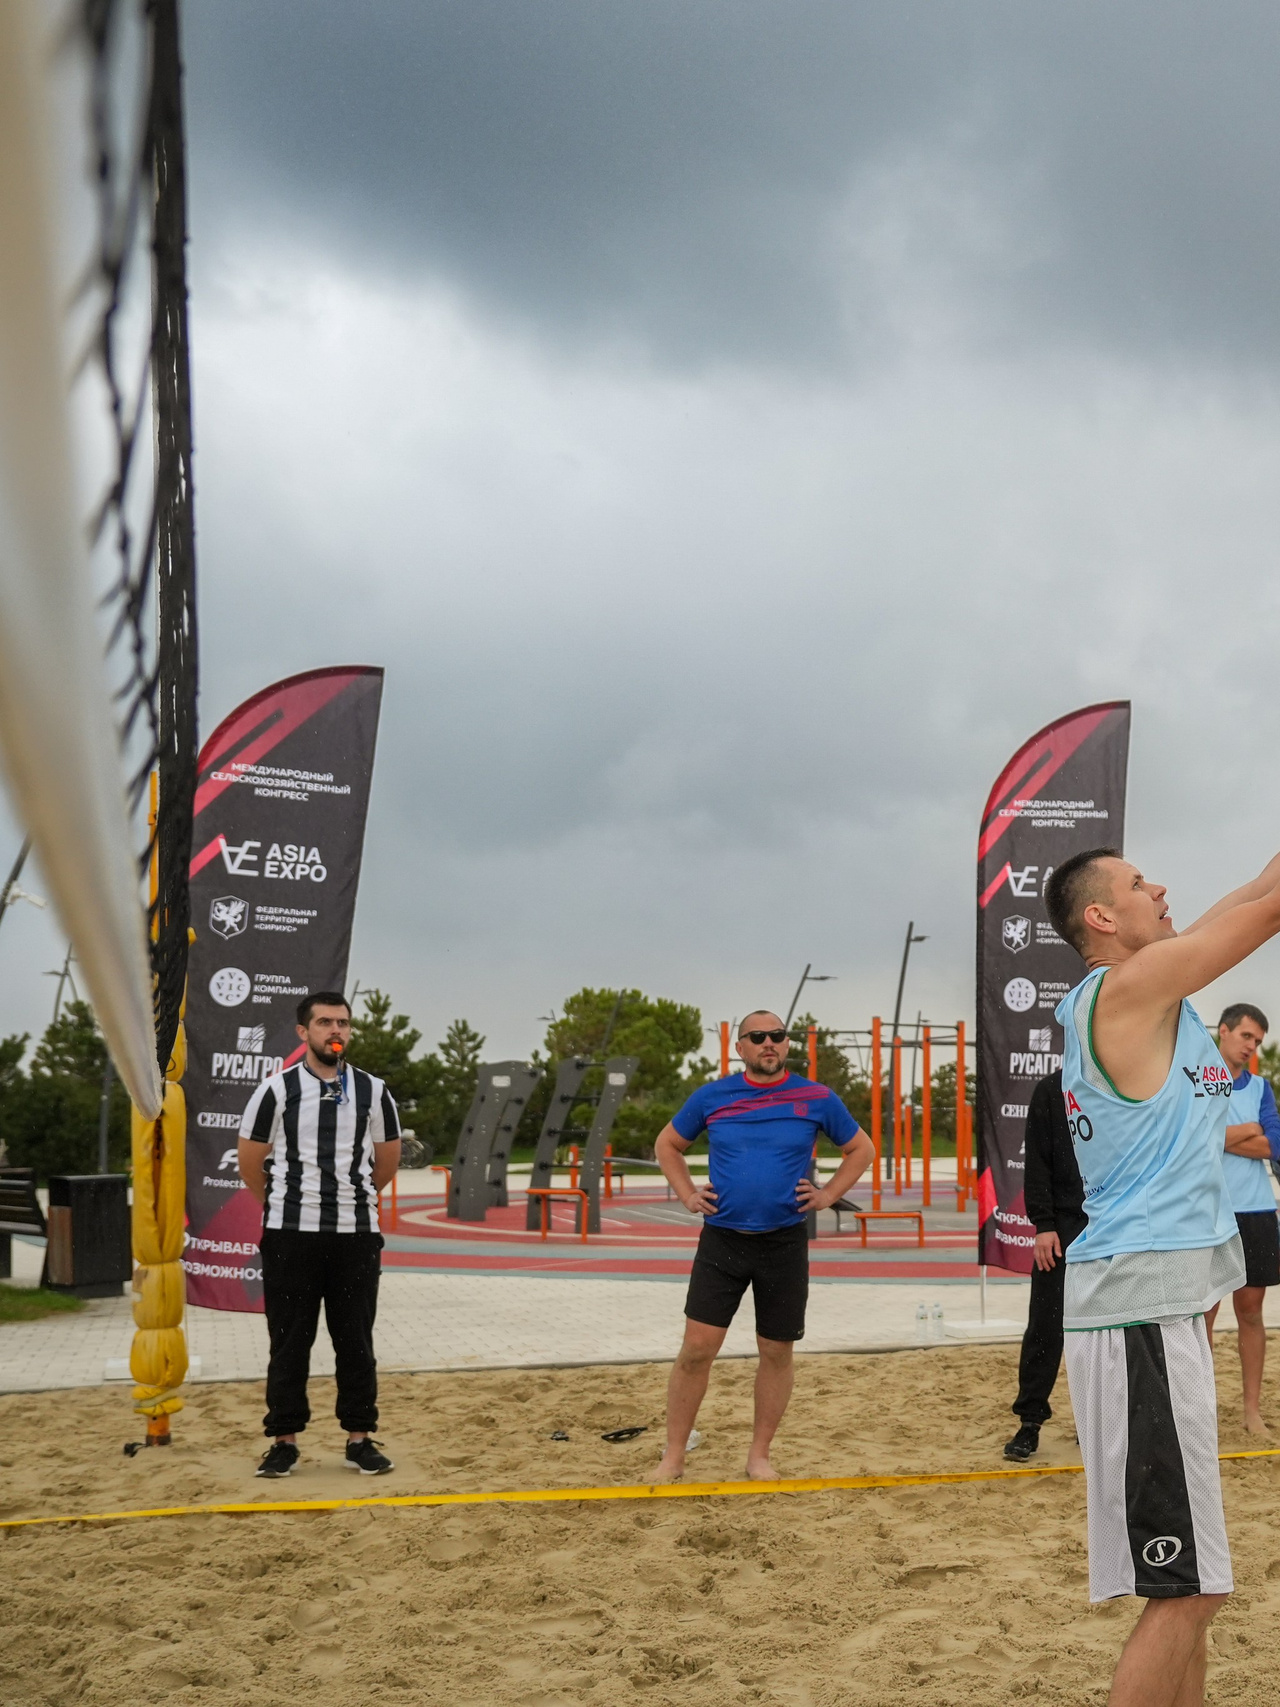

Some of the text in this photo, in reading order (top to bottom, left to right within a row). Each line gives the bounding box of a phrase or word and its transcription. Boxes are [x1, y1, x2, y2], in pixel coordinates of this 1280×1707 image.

[231, 762, 334, 783] МЕЖДУНАРОДНЫЙ
[210, 771, 351, 795] СЕЛЬСКОХОЗЯЙСТВЕННЫЙ
[254, 787, 309, 801] КОНГРЕСС
[1013, 799, 1095, 809] МЕЖДУНАРОДНЫЙ
[998, 808, 1109, 820] СЕЛЬСКОХОЗЯЙСТВЕННЫЙ
[1031, 818, 1076, 829] КОНГРЕСС
[266, 843, 321, 864] ASIA
[264, 861, 327, 882] EXPO
[255, 905, 317, 917] ФЕДЕРАЛЬНАЯ
[255, 914, 309, 925] ТЕРРИТОРИЯ
[254, 923, 297, 933] «СИРИУС»
[254, 974, 291, 984] ГРУППА
[254, 984, 309, 996] КОМПАНИЙ
[1039, 982, 1070, 990] ГРУППА
[252, 994, 272, 1004] ВИК
[1038, 1000, 1055, 1008] ВИК
[212, 1053, 284, 1079] РУСАГРО
[1202, 1066, 1230, 1082] ASIA
[1204, 1082, 1233, 1098] EXPO
